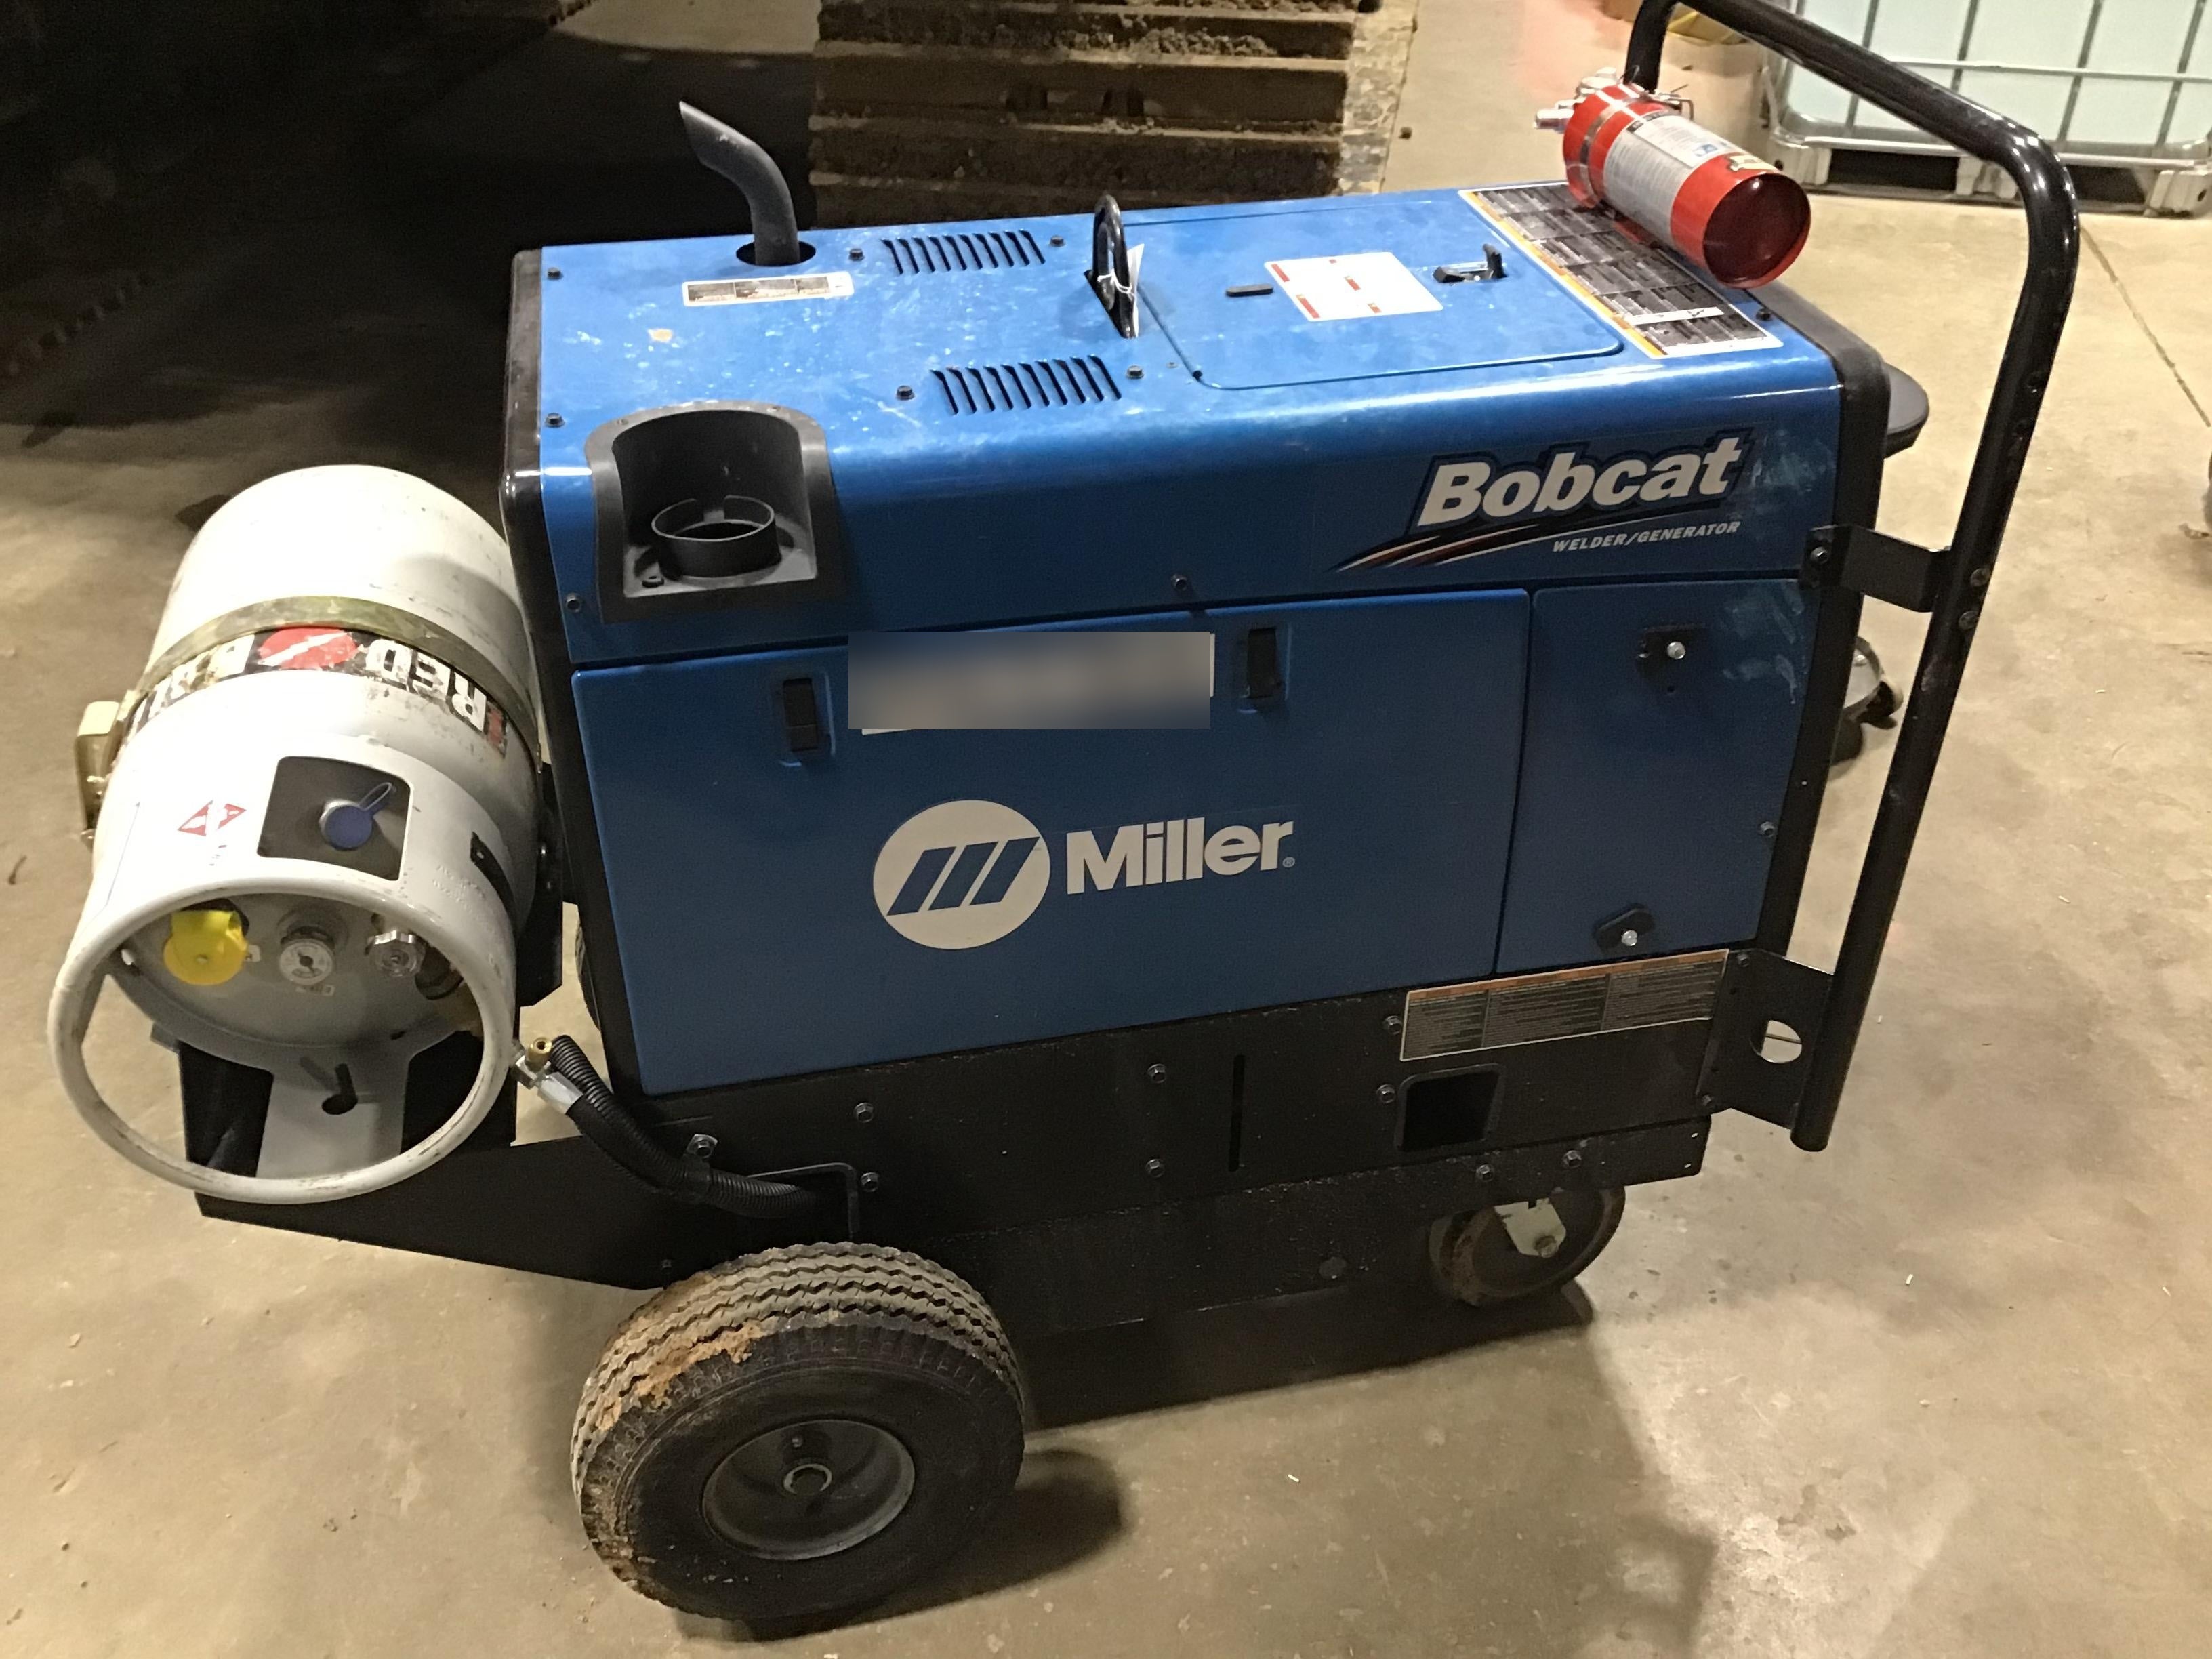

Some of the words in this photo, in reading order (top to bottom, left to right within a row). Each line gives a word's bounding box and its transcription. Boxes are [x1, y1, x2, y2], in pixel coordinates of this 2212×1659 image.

[1418, 437, 1744, 527] Bobcat
[1553, 520, 1741, 552] WELDER/GENERATOR
[365, 638, 487, 733] RED
[1066, 817, 1294, 895] Miller
